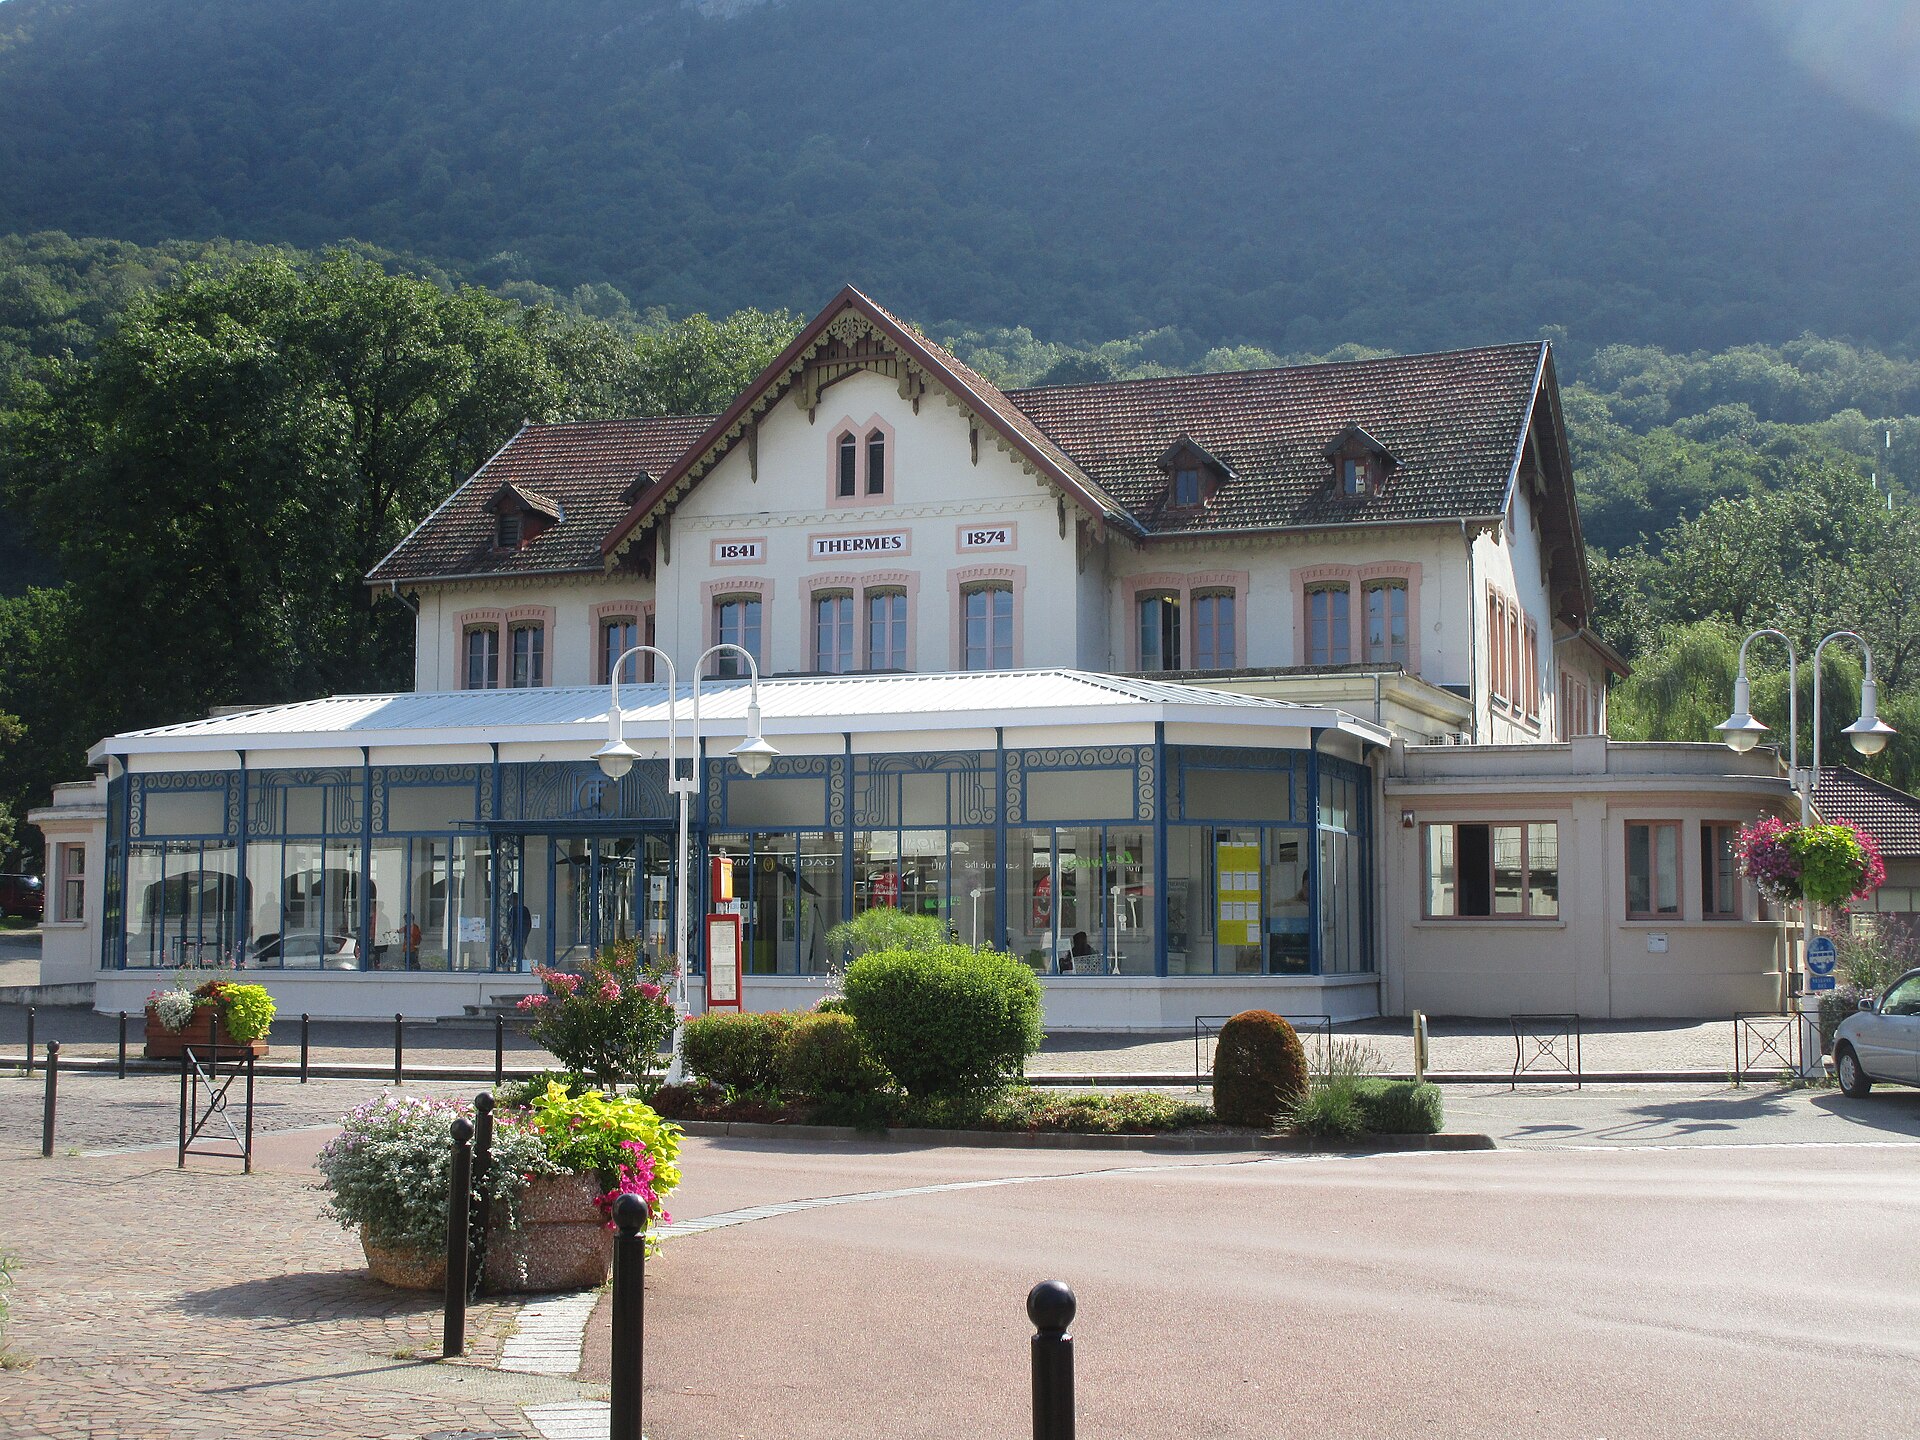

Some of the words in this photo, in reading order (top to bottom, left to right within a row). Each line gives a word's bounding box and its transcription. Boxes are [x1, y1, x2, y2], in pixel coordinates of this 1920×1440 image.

[817, 536, 902, 554] THERMES
[967, 530, 1006, 545] 1874
[721, 545, 755, 558] 1841
